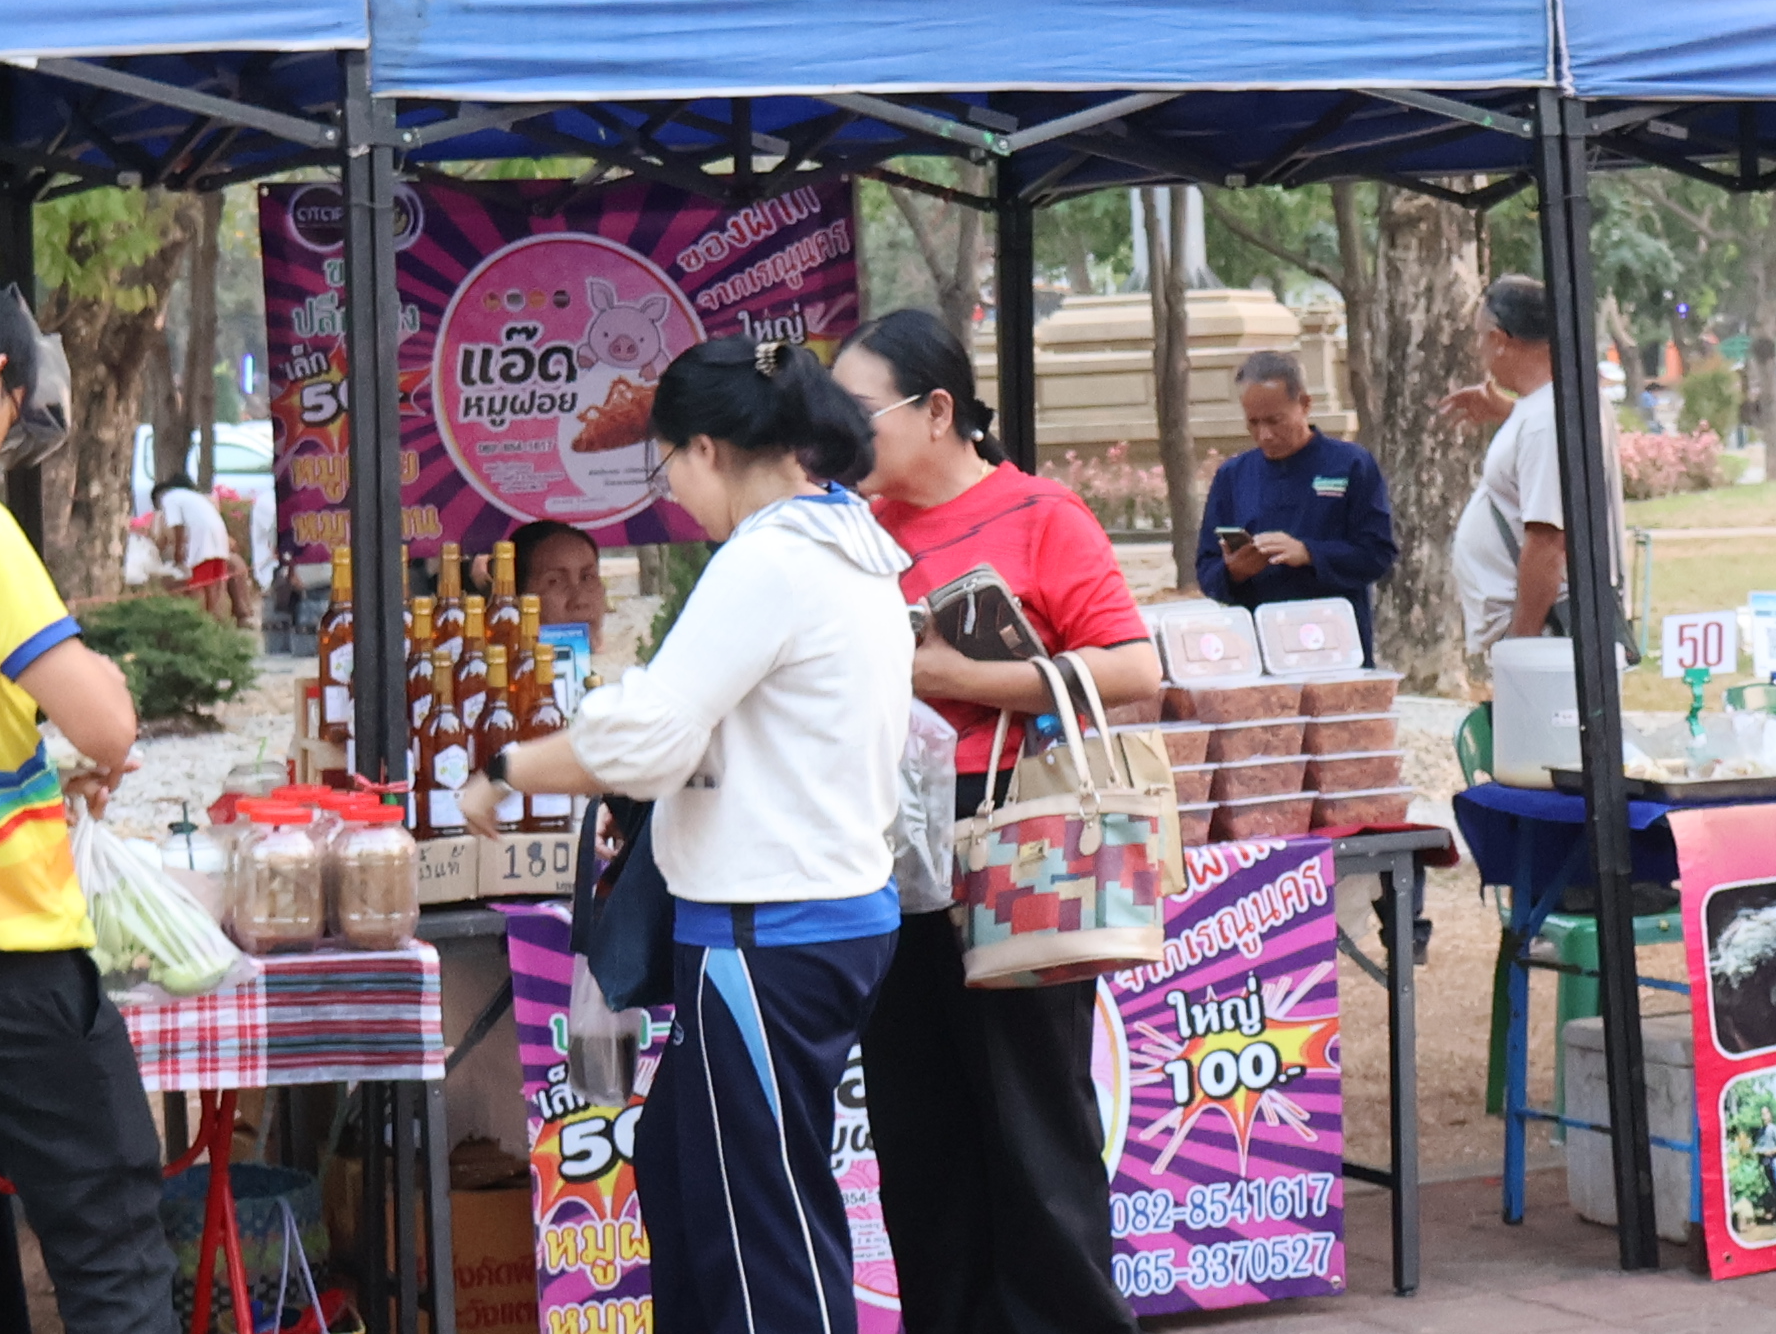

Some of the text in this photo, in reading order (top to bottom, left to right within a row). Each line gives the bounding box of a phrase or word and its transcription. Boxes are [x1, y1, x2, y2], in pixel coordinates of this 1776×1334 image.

[463, 390, 578, 428] หมูฝอย
[1678, 621, 1723, 668] 50
[503, 841, 570, 879] 180
[1166, 975, 1264, 1037] ใหญ่
[1111, 1176, 1330, 1234] 082-8541617
[1112, 1234, 1331, 1293] 065-3370527
